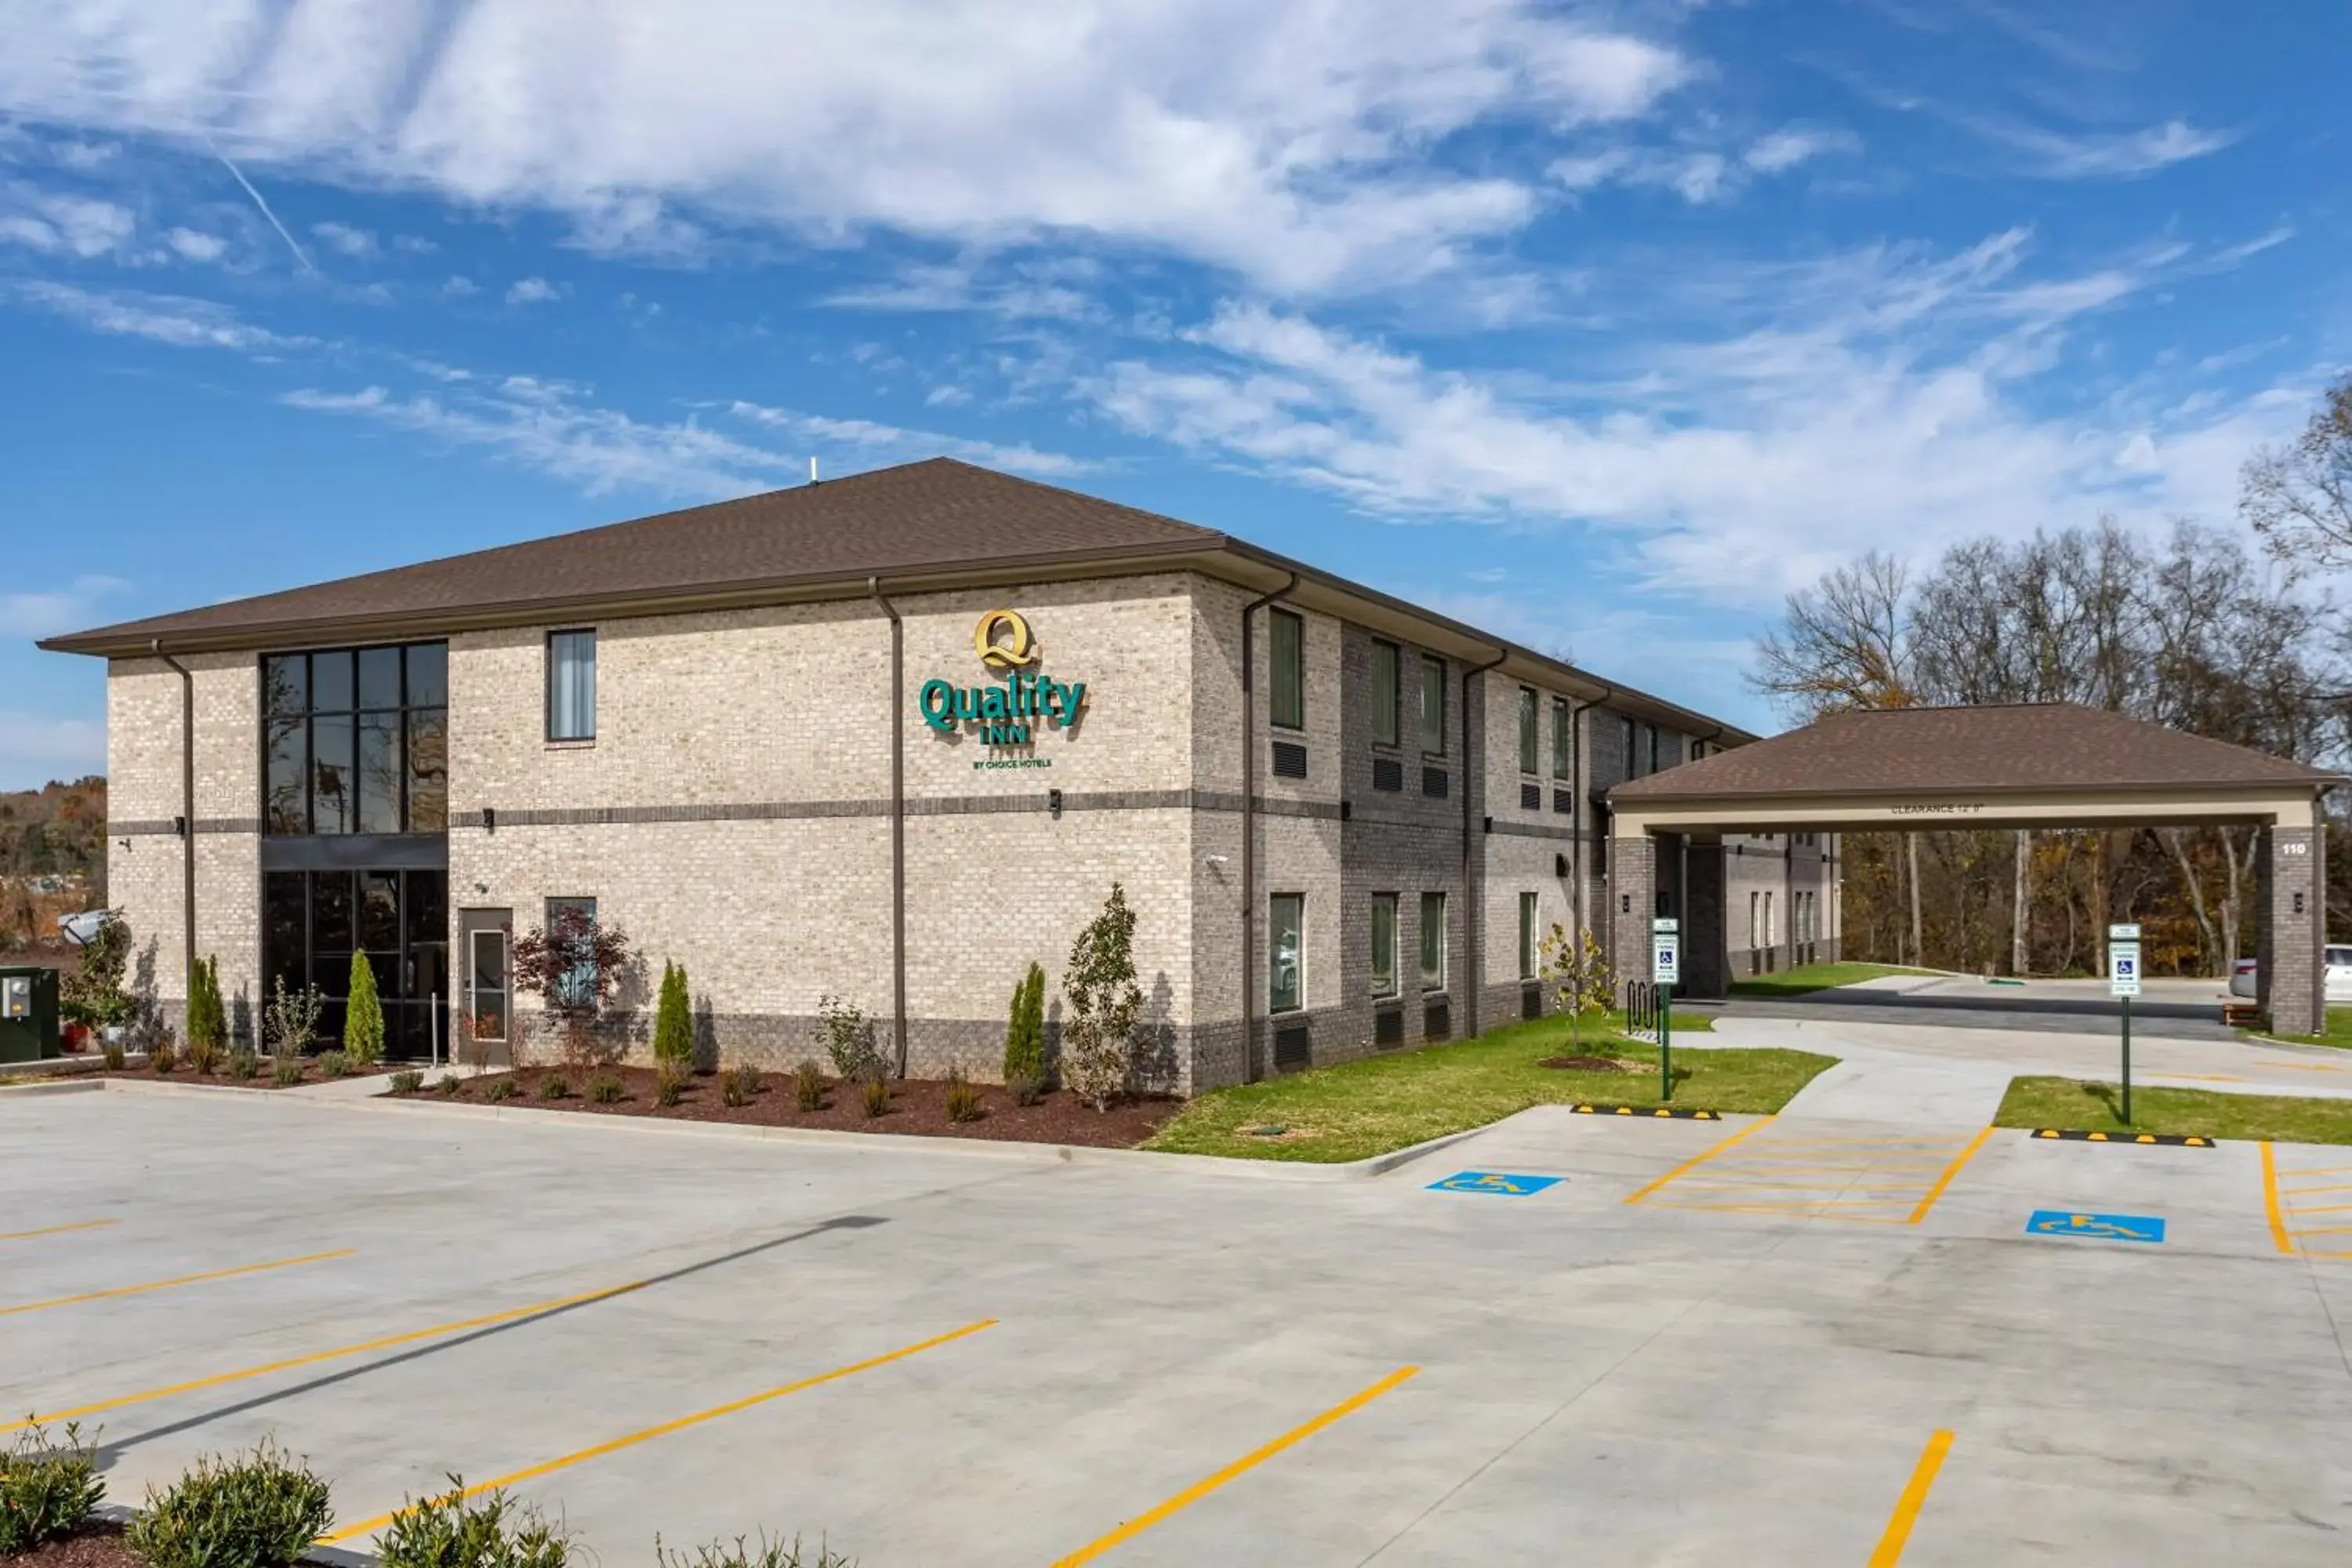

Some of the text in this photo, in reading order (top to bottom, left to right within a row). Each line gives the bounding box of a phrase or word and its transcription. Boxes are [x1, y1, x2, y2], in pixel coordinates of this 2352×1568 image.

[975, 609, 1032, 666] Q
[920, 673, 1086, 731] Quality
[980, 724, 1028, 745] INN
[985, 760, 1017, 769] CHOICE
[1019, 758, 1051, 768] HOTELS
[1892, 804, 1955, 814] CLEARANCE
[2282, 843, 2306, 854] 110
